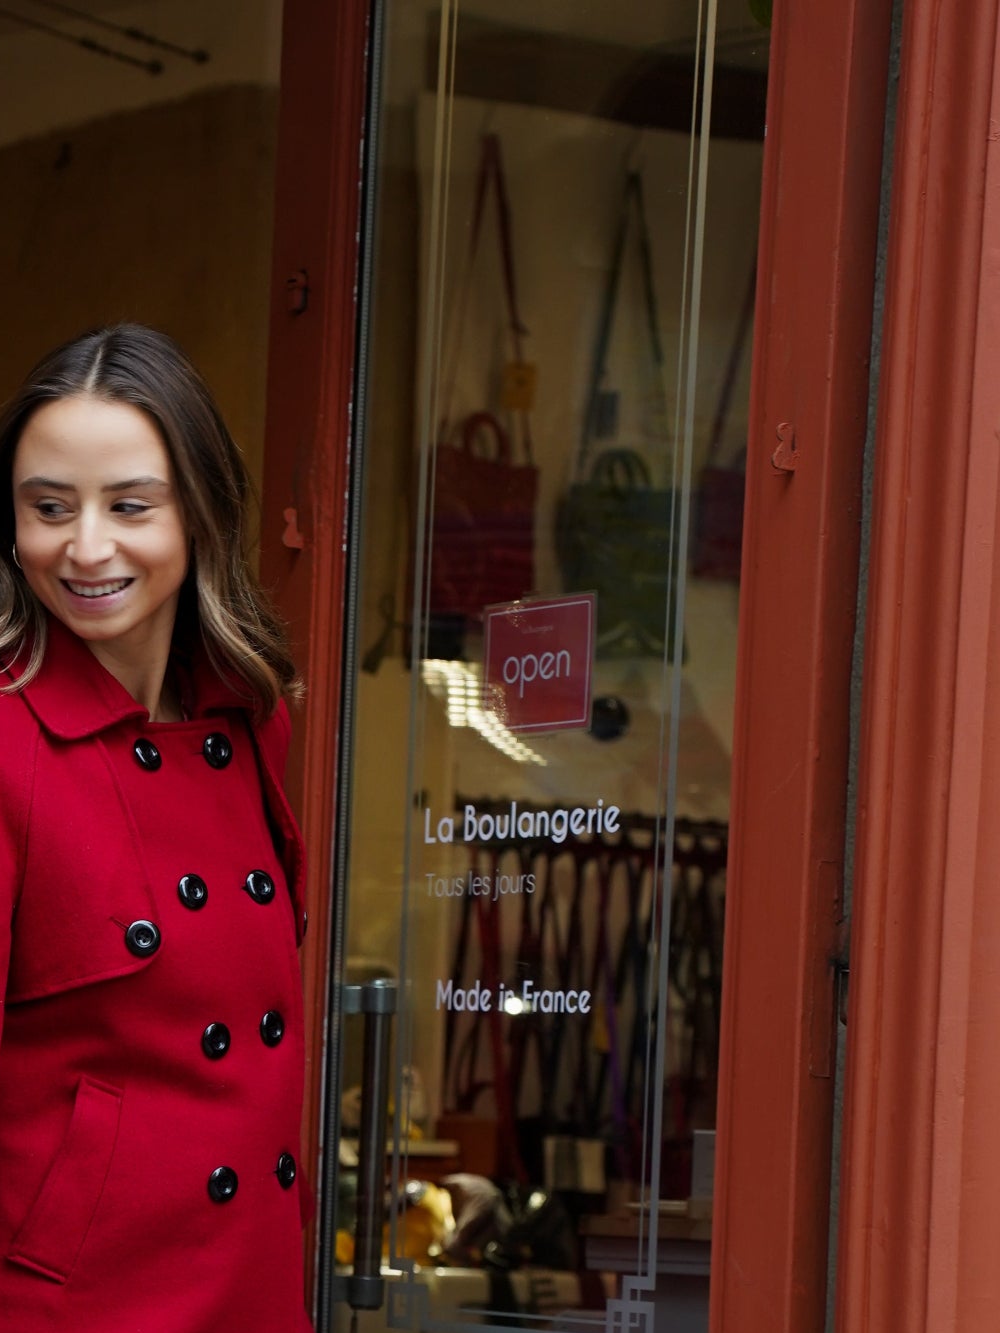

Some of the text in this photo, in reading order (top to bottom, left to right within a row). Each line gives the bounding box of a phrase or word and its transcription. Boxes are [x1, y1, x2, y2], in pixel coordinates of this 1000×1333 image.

[503, 649, 571, 699] open
[424, 798, 621, 844] La Boulangerie
[425, 868, 536, 902] Tous les jours
[435, 979, 492, 1012] Made
[522, 980, 591, 1014] France
